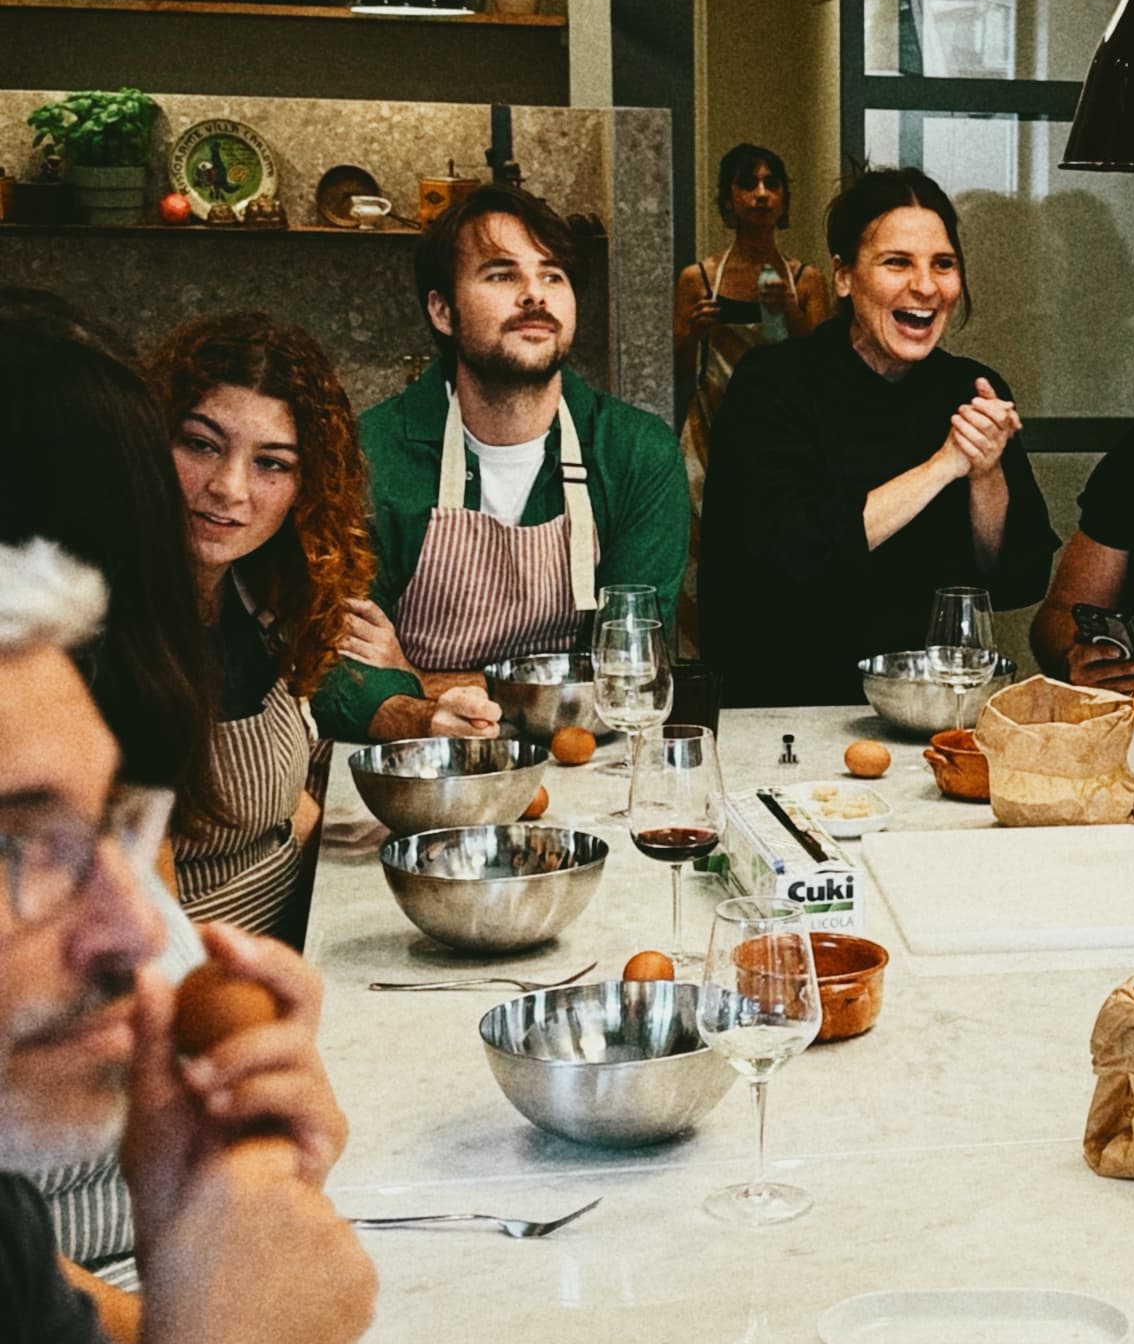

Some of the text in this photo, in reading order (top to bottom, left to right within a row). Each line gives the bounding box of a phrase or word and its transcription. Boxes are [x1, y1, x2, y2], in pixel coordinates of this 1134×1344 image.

[204, 123, 240, 133] VILLA
[788, 875, 854, 902] Cuki
[811, 917, 854, 929] LICOLA
